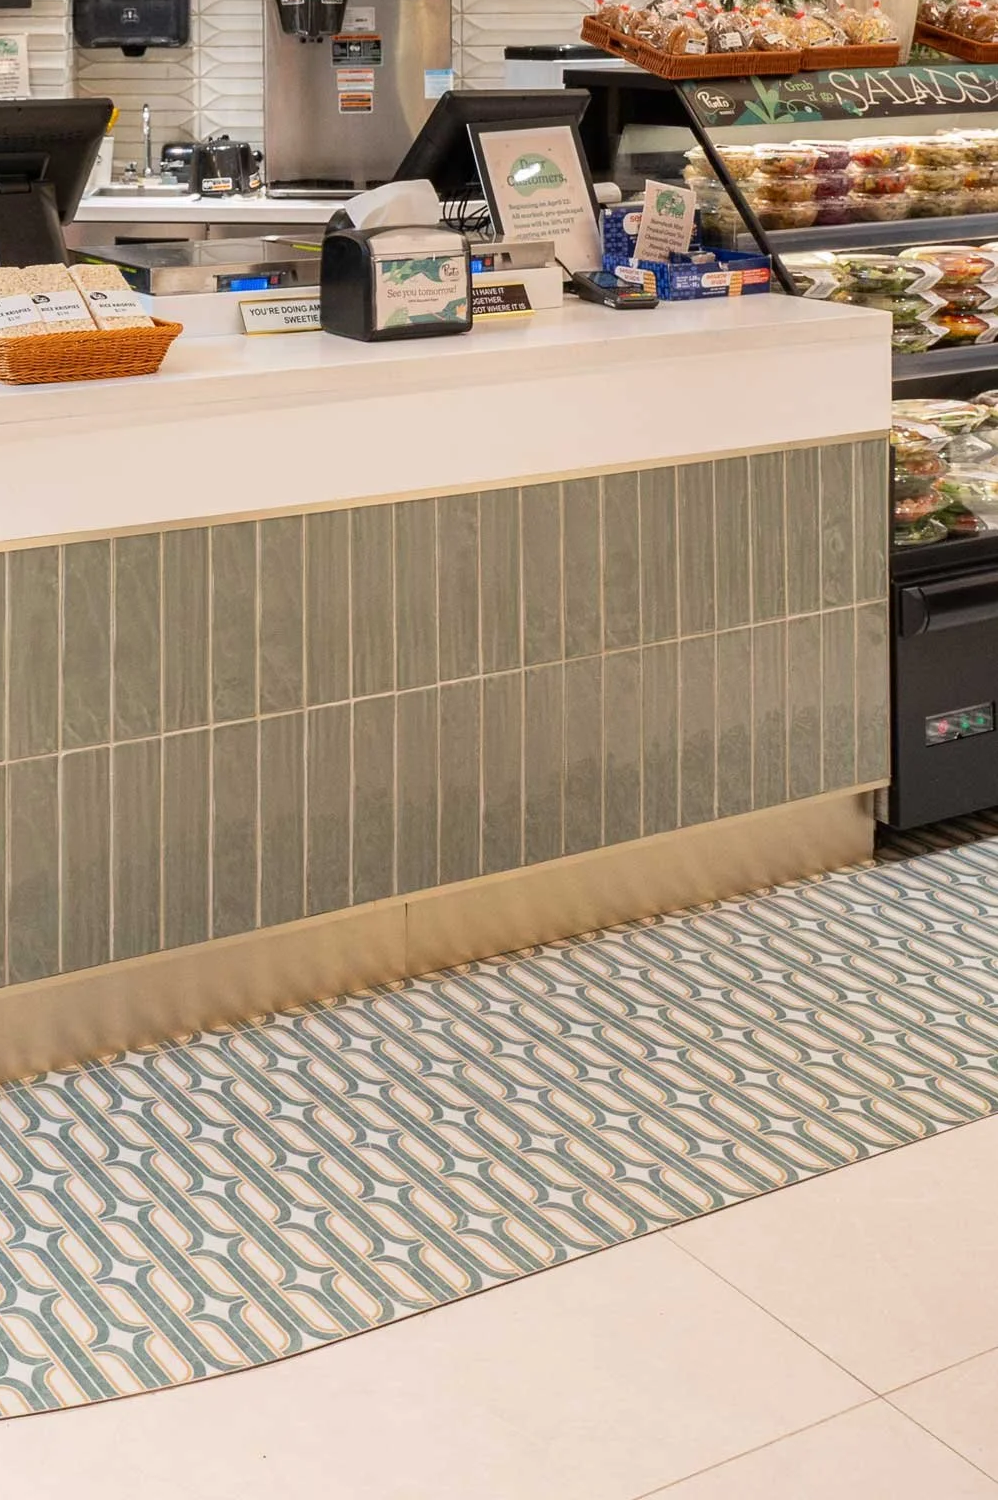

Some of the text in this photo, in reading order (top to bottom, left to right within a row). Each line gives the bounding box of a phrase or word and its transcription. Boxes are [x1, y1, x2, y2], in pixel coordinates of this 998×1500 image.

[784, 67, 992, 112] Grab SALADS
[696, 90, 730, 109] Pinto
[820, 92, 835, 103] go
[387, 284, 457, 299] See you tomorrow!
[249, 306, 280, 316] YOU'RE
[281, 305, 307, 314] DOING
[486, 304, 511, 313] WHERE
[284, 314, 319, 324] SWEETIE
